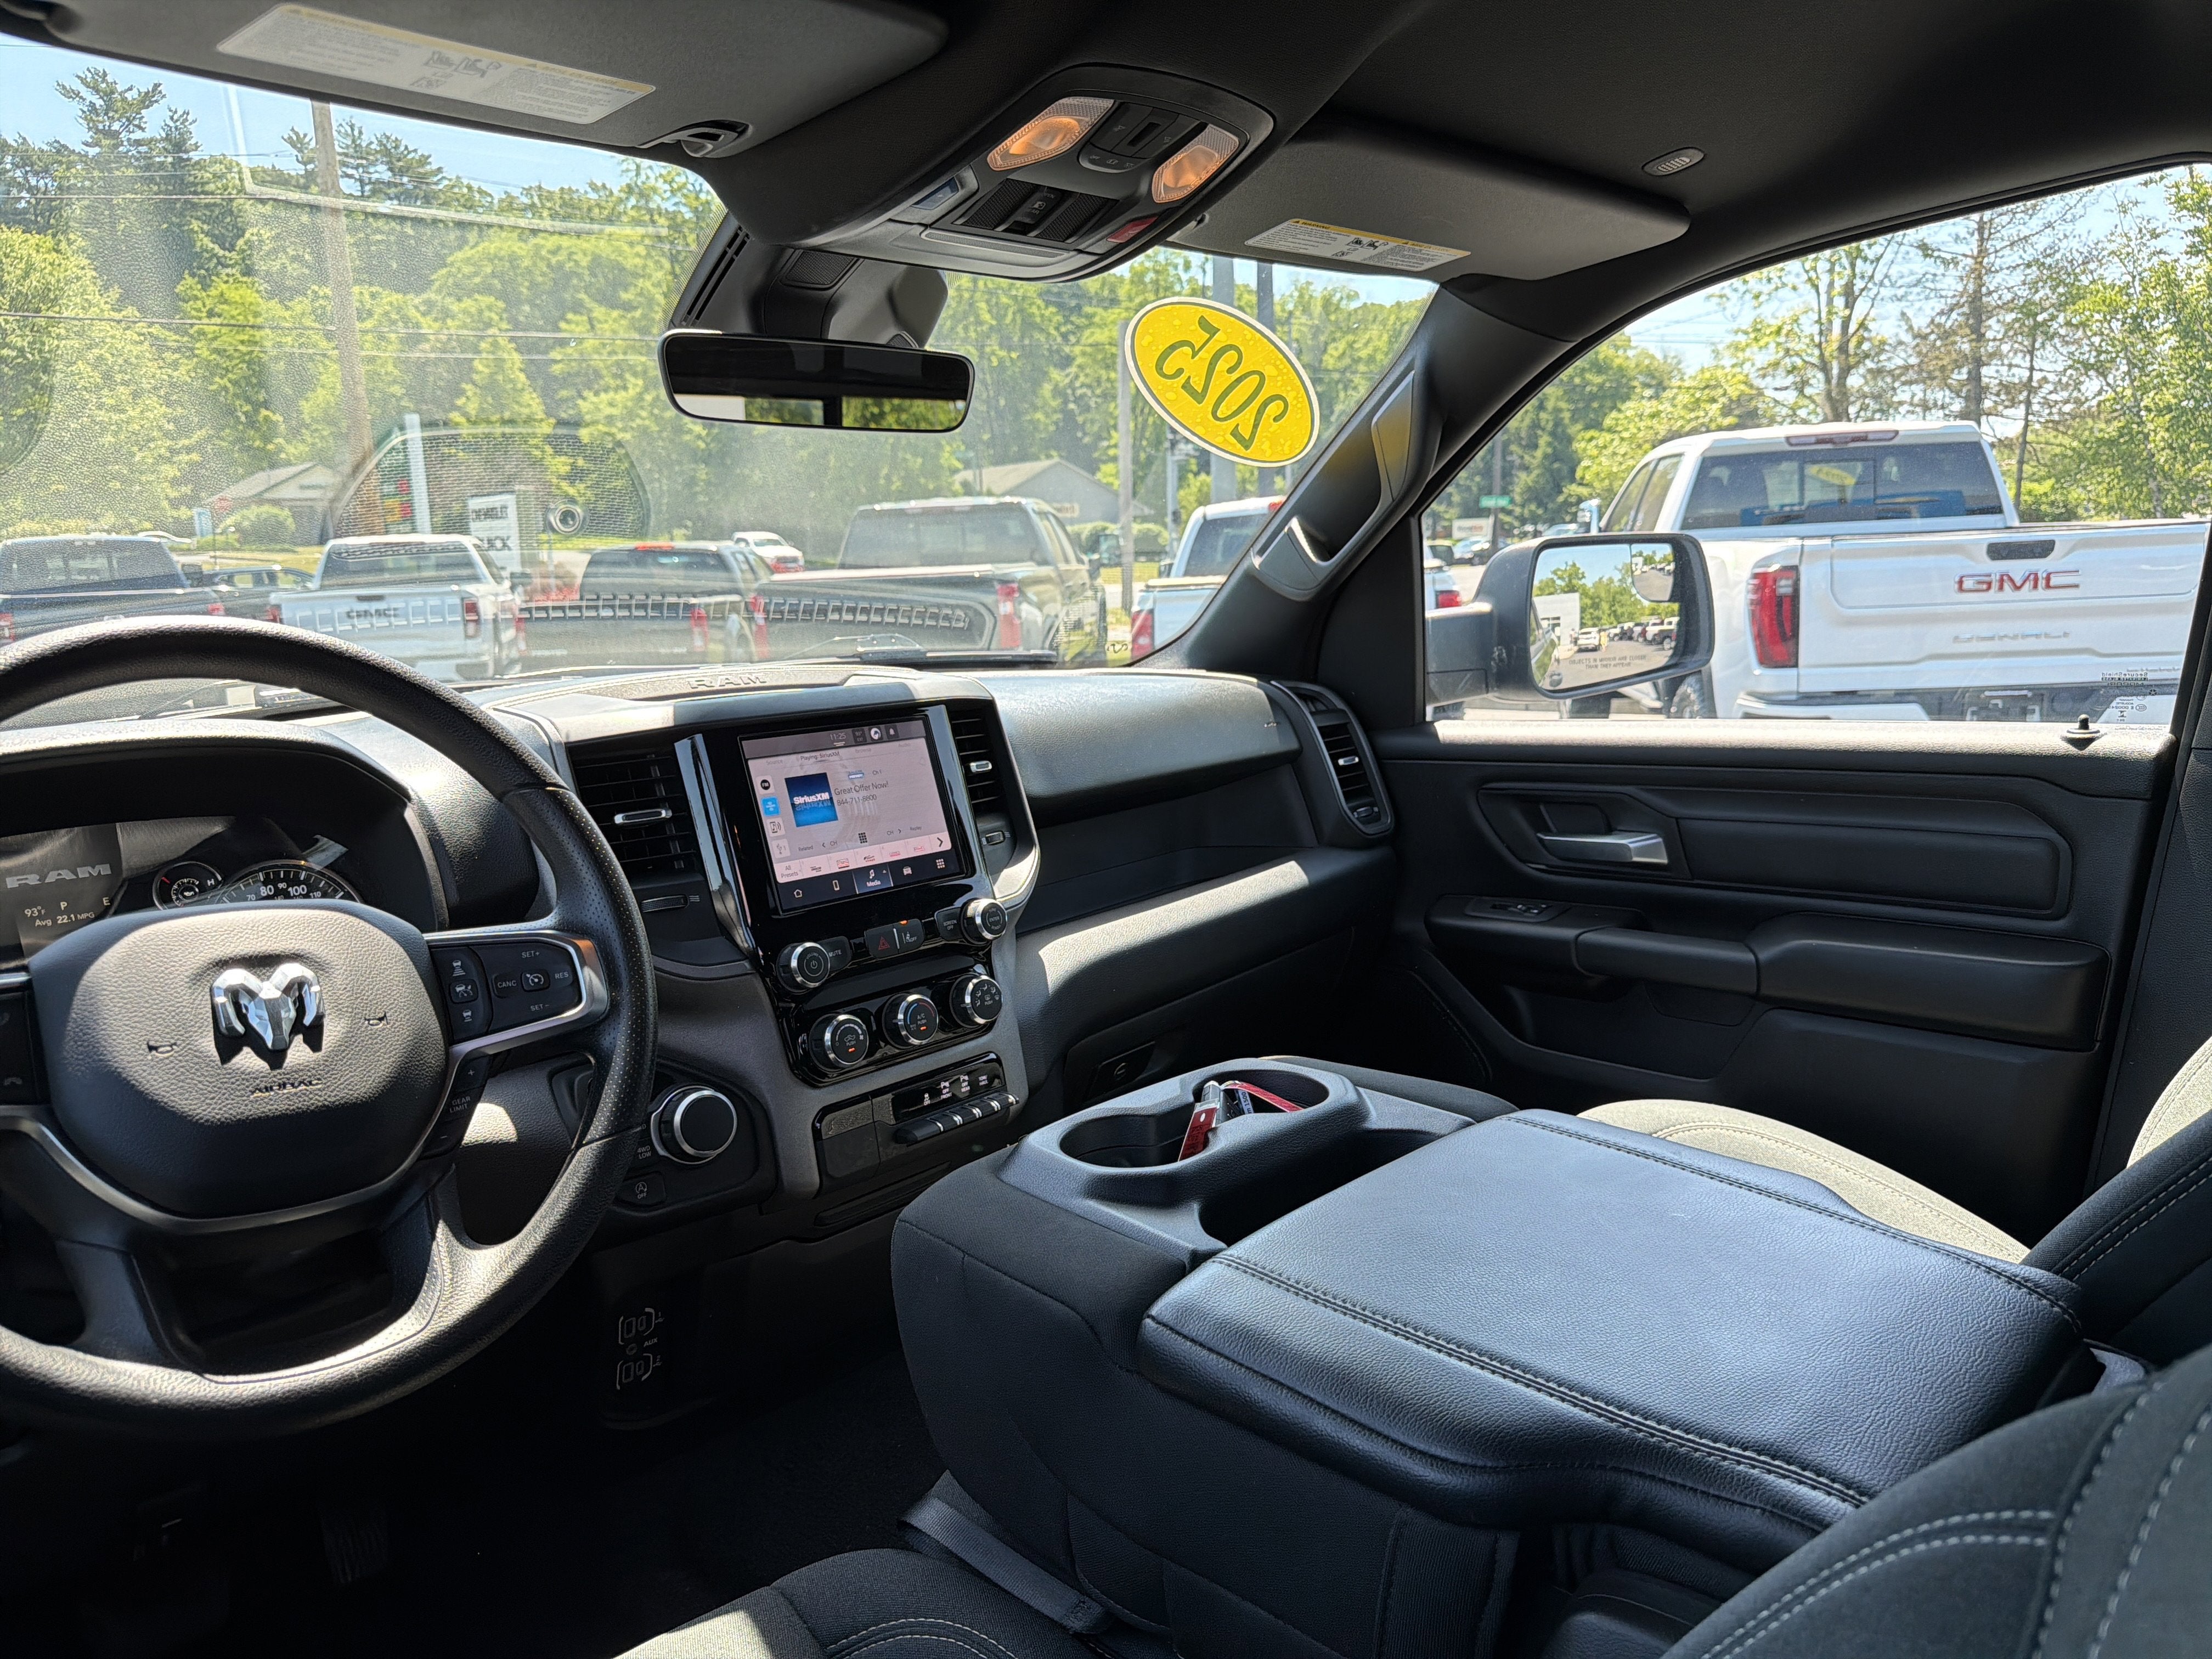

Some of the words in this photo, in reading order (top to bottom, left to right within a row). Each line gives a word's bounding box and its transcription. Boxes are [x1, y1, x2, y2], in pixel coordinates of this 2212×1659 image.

[1954, 569, 2080, 594] GMC
[830, 732, 847, 741] 11:25
[834, 787, 853, 795] Great
[854, 784, 871, 793] Offer
[872, 781, 889, 789] Now!
[793, 792, 830, 805] SiriusXM
[837, 794, 877, 806] 844-711-8800
[5, 864, 111, 889] RAM
[259, 885, 274, 896] 80
[287, 884, 307, 896] 100
[60, 901, 67, 911] P
[103, 897, 111, 906] E
[35, 918, 52, 927] Avg
[57, 913, 76, 924] 22.1
[77, 912, 95, 921] MPG
[829, 949, 842, 957] MUTE
[555, 971, 569, 980] RES
[498, 979, 517, 988] CANC
[452, 1097, 471, 1106] GEAR
[1241, 1092, 1250, 1107] 1500
[449, 1103, 468, 1114] LIMIT
[637, 1145, 651, 1153] 4WD
[639, 1152, 651, 1160] LOW
[644, 1338, 658, 1347] AUX
